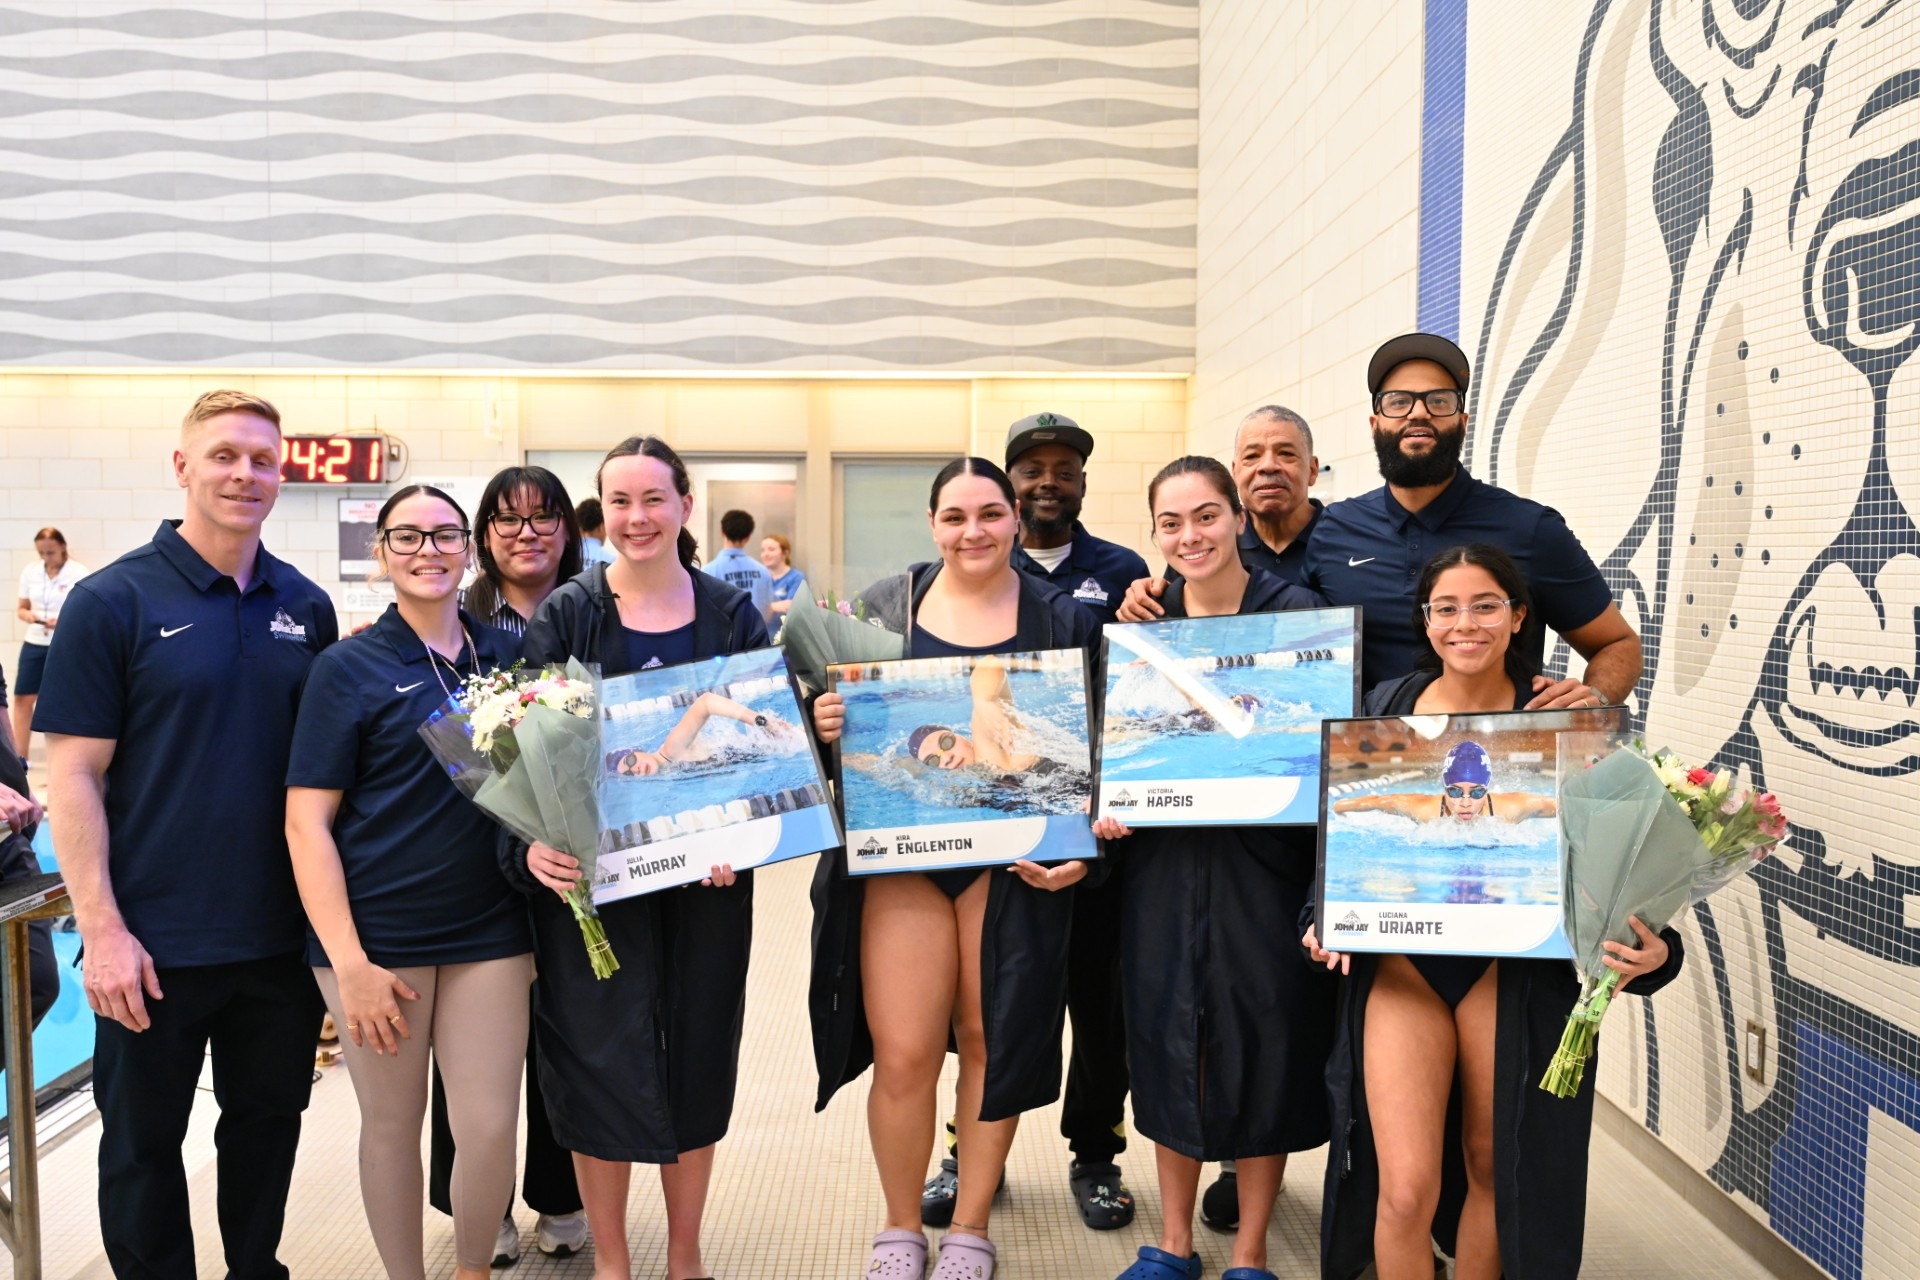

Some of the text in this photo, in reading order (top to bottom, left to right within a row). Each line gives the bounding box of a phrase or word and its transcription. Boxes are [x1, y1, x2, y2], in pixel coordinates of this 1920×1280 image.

[1126, 799, 1138, 807] JAY
[1147, 795, 1193, 807] HAPSIS
[897, 838, 972, 854] ENGLENTON
[857, 847, 888, 856] JOHN JAY
[626, 855, 644, 865] JULIA
[629, 854, 686, 879] MURRAY
[607, 873, 620, 883] JAY
[1334, 923, 1369, 931] JOHN JAY
[1379, 920, 1443, 935] URIARTE
